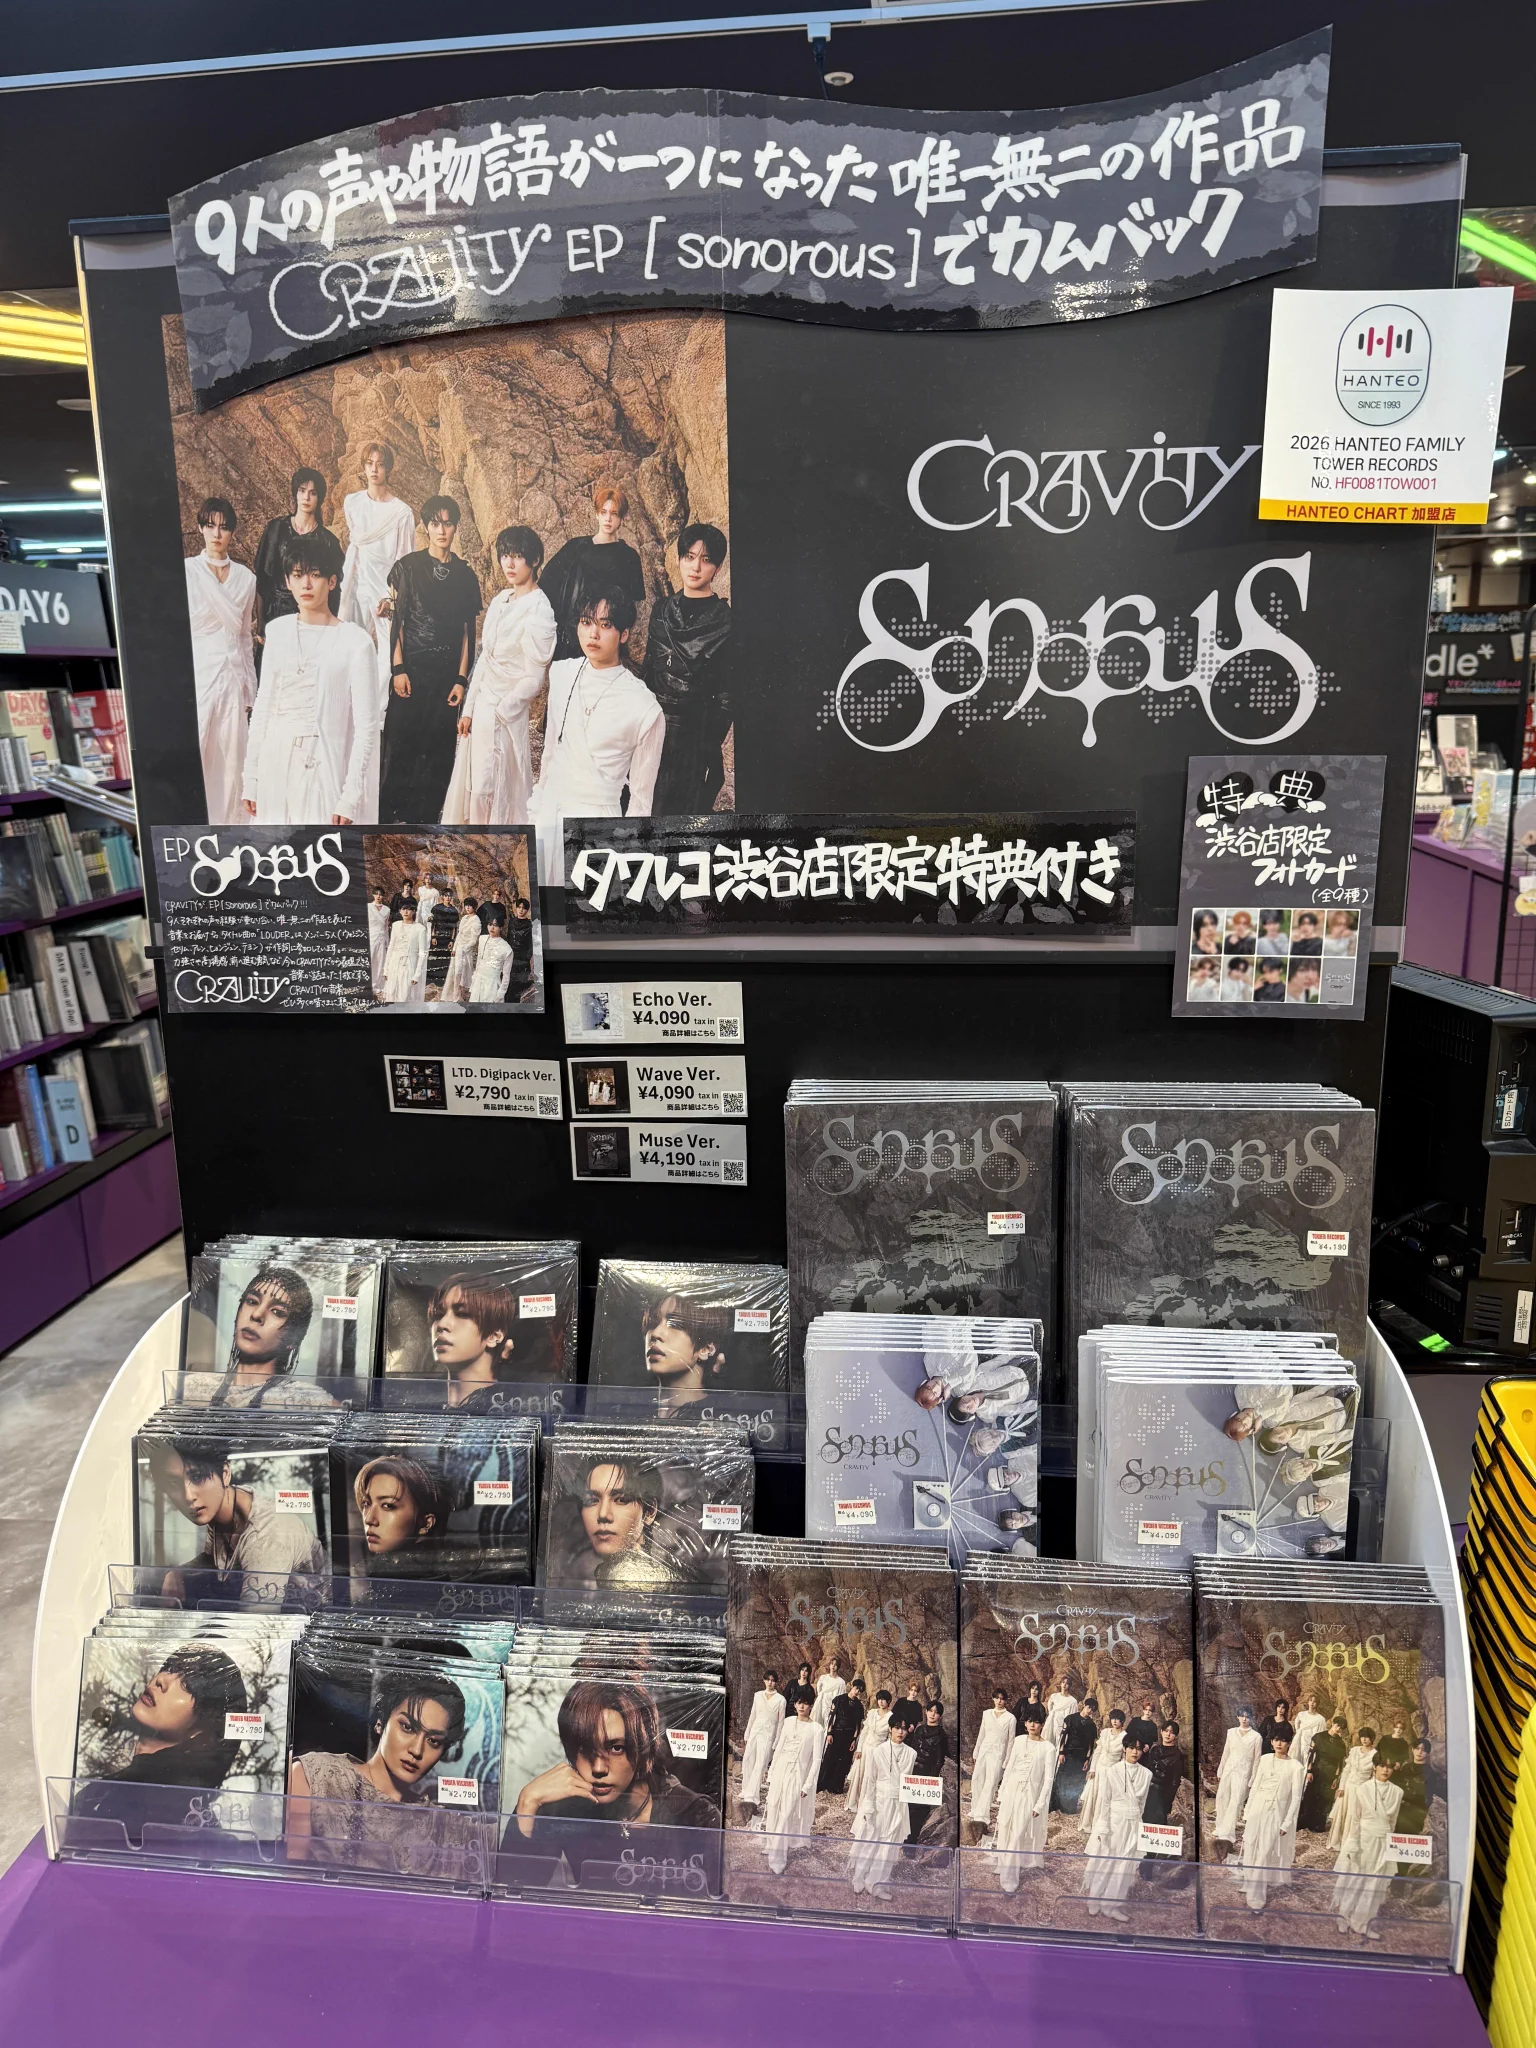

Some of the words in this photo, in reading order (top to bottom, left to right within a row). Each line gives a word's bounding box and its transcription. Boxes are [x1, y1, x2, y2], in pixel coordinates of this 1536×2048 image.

[568, 224, 623, 273] EP
[1343, 374, 1420, 387] HANTEO
[1357, 400, 1381, 409] SINCE
[1382, 400, 1401, 409] 1993
[1290, 435, 1330, 450] 2026
[1334, 436, 1401, 451] HANTEO
[1405, 437, 1466, 452] FAMILY
[1312, 456, 1364, 471] TOWER
[1368, 457, 1438, 471] RECORDS
[1310, 475, 1332, 490] NO.
[1335, 477, 1437, 490] HF0081TOW001
[1286, 505, 1349, 519] HANTEO
[1353, 506, 1408, 520] CHART
[1411, 506, 1456, 521] 加盟店
[1204, 823, 1333, 858] 渋谷店限定
[163, 837, 191, 864] EP
[570, 832, 1121, 912] タワレコ渋谷店限定特典付き
[1251, 853, 1358, 887] フォトカード
[632, 991, 675, 1008] Echo
[678, 991, 713, 1008] Ver.
[632, 1010, 690, 1027] ¥4,090
[707, 1017, 715, 1025] in
[661, 1029, 716, 1038] 商品詳細はこちら
[451, 1067, 478, 1079] LTD.
[479, 1067, 532, 1083] Digipack
[533, 1069, 556, 1082] Ver.
[635, 1066, 682, 1082] Wave
[685, 1066, 721, 1082] Ver.
[454, 1084, 511, 1101] ¥2,790
[527, 1093, 535, 1101] in
[637, 1085, 695, 1101] ¥4,090
[711, 1091, 719, 1099] in
[483, 1103, 535, 1112] 商品詳細はこちら
[666, 1103, 720, 1111] 商品詳細はこちら
[66, 1124, 80, 1145] D
[639, 1132, 683, 1149] Muse
[686, 1133, 720, 1149] Ver.
[638, 1151, 696, 1168] ¥4,190
[698, 1159, 711, 1167] tax
[711, 1159, 720, 1167] in
[667, 1169, 720, 1178] 商品詳細はこちら
